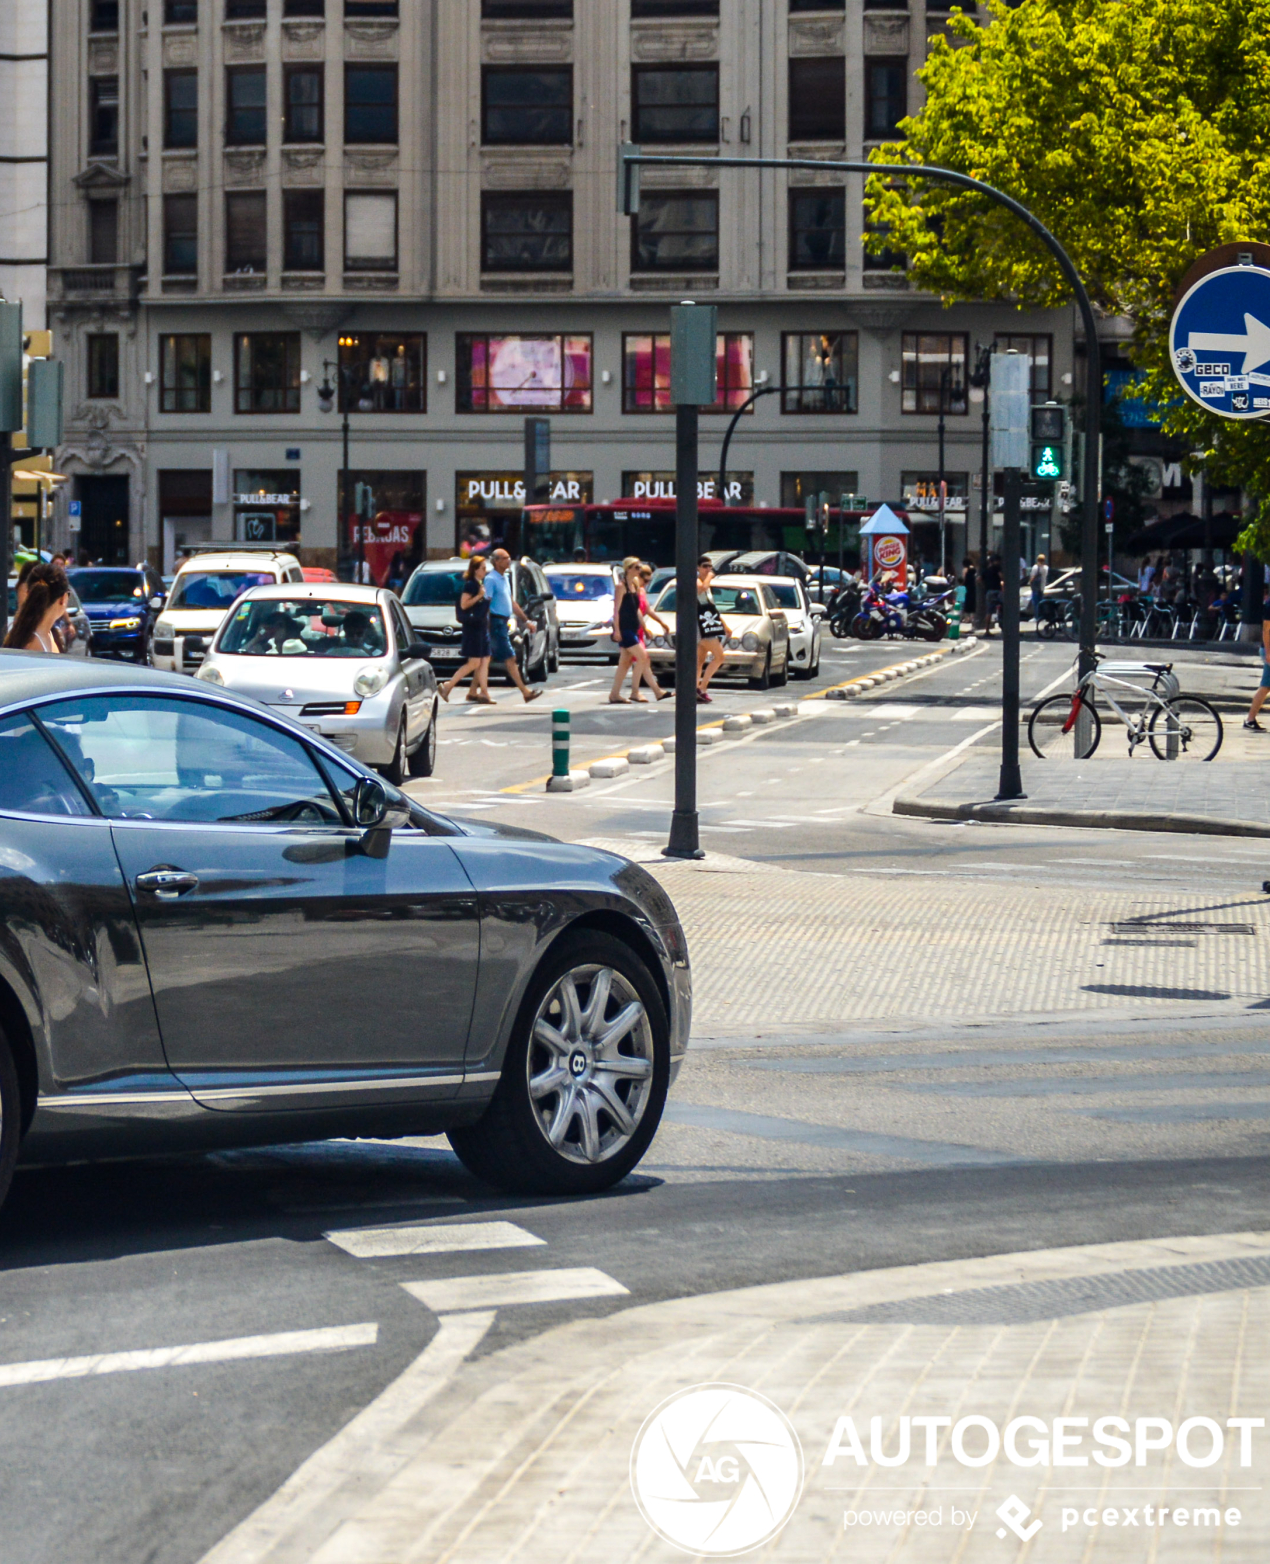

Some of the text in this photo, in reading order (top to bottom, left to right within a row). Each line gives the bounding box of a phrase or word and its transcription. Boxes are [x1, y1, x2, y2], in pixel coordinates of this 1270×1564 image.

[468, 480, 580, 499] PULL&AR
[634, 481, 742, 499] PULLBER
[240, 493, 291, 504] PULL&BEAR
[909, 497, 962, 508] PULL&EAR
[353, 525, 409, 544] REBJAS
[879, 547, 901, 560] KING
